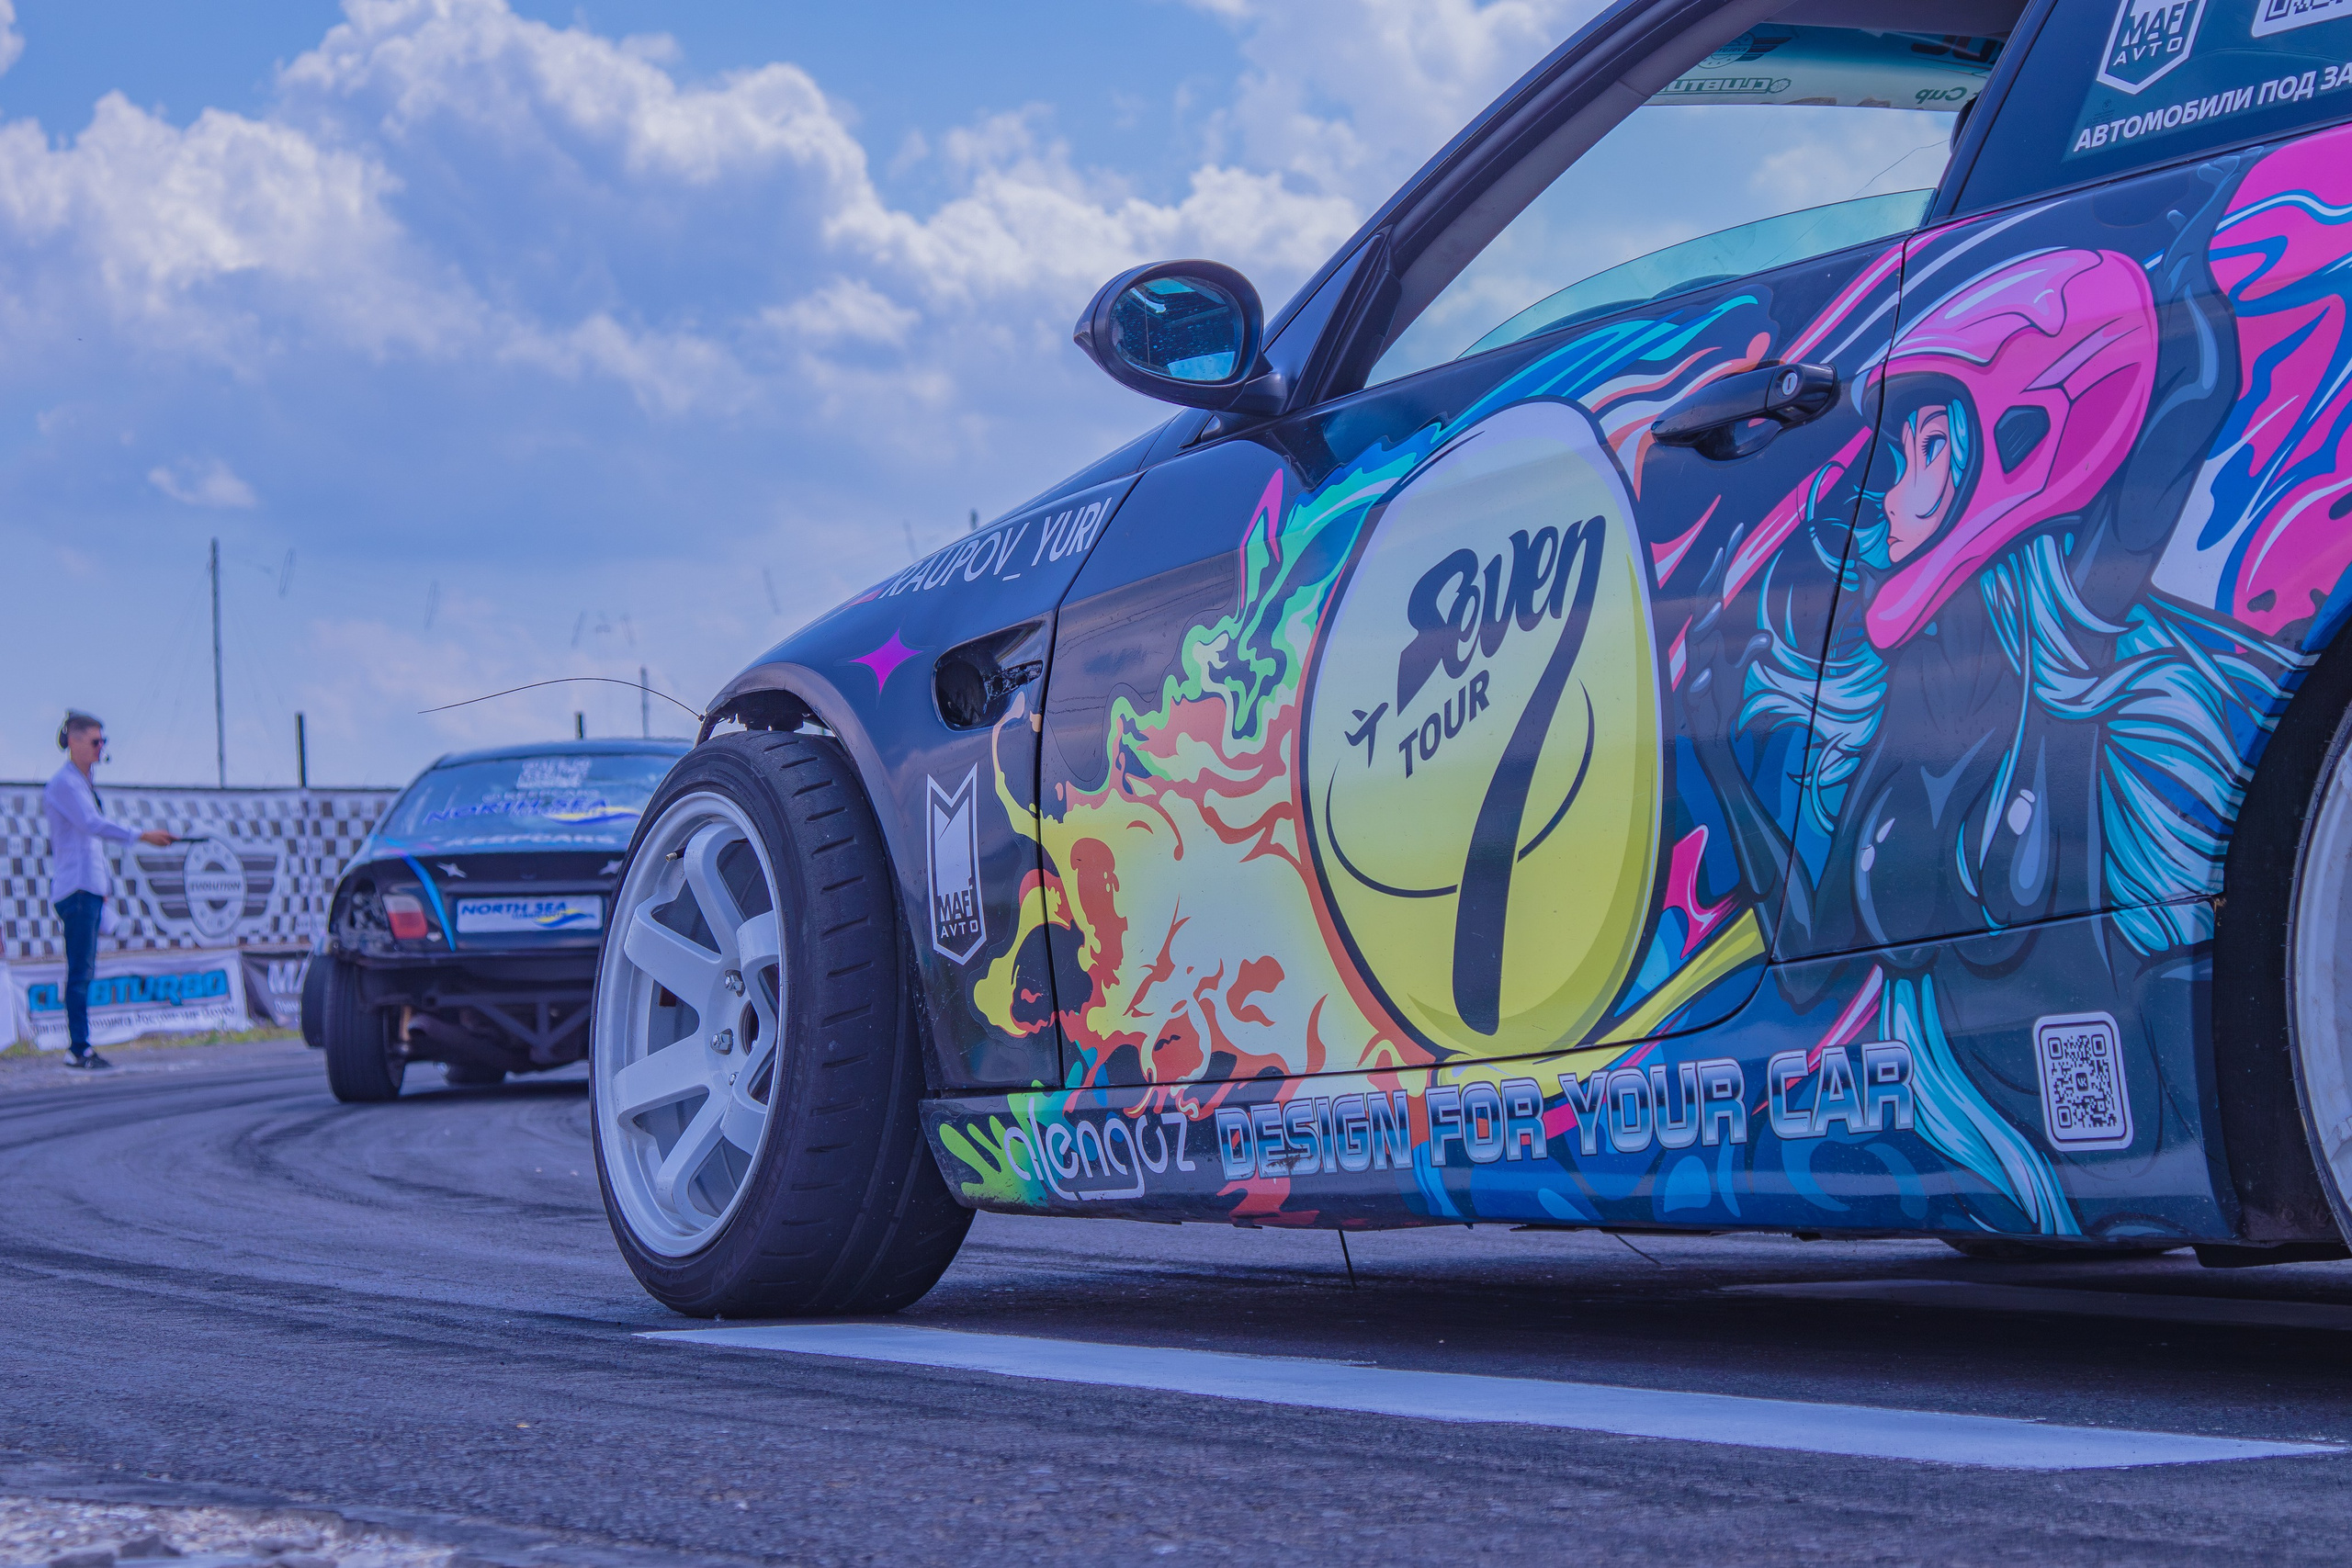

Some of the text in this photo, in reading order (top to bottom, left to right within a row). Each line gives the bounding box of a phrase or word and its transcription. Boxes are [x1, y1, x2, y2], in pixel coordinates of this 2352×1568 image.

[2112, 36, 2184, 66] AVTO
[2073, 86, 2255, 152] АВТОМОБИЛИ
[2256, 71, 2317, 106] ПОД
[1397, 669, 1491, 779] TOUR
[461, 903, 527, 916] NORTH
[536, 901, 567, 911] SEA
[937, 888, 971, 923] MAF
[940, 919, 978, 939] AVTO
[28, 969, 229, 1011] CLBTURBO
[1216, 1039, 1917, 1181] DESIGN FOR YOUR CAR
